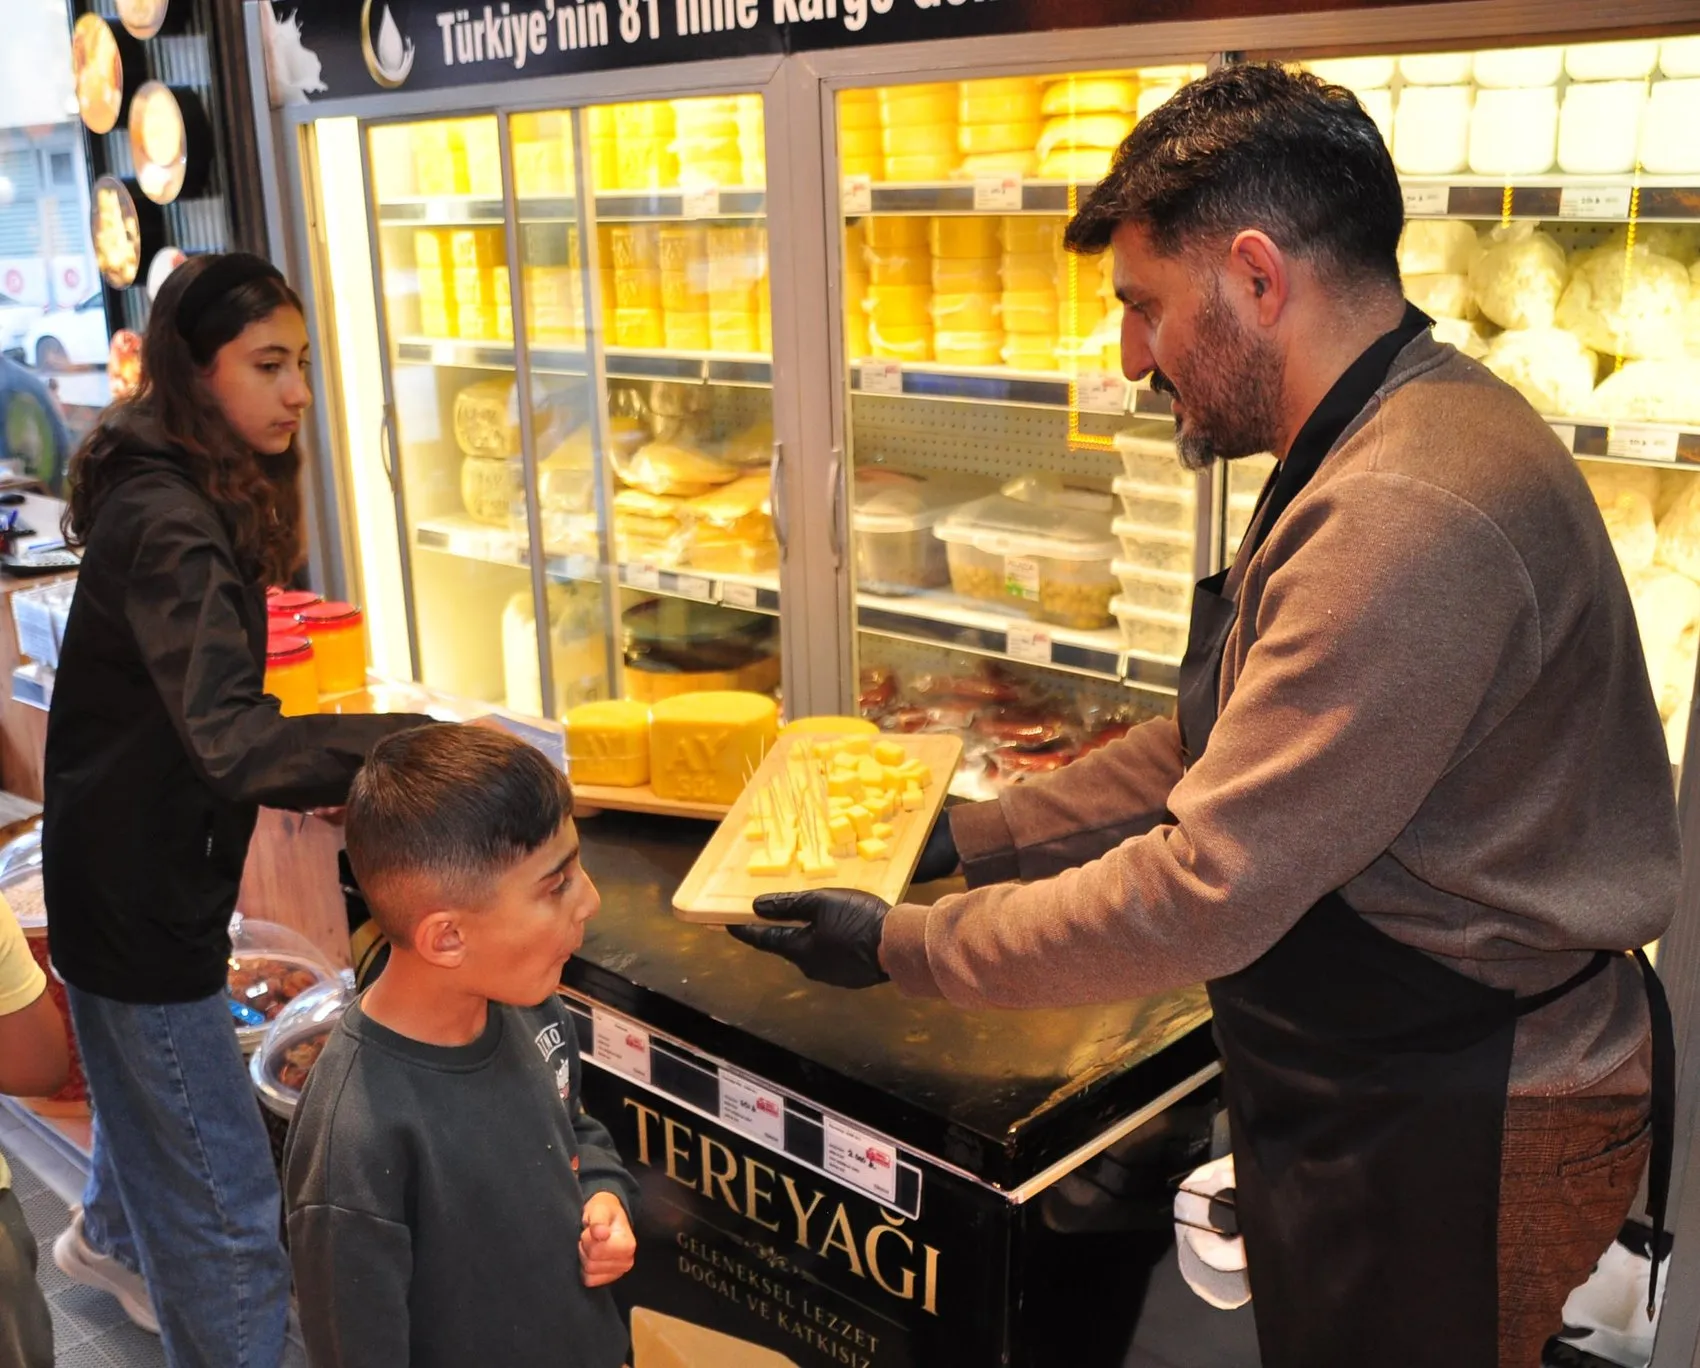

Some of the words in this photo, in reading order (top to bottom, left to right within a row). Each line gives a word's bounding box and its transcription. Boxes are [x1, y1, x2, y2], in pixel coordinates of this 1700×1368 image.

[436, 0, 609, 69] Türkiye'nin
[619, 0, 660, 43] 81
[623, 1098, 942, 1317] TEREYAĞI
[676, 1231, 795, 1309] GELENEKSEL
[803, 1300, 880, 1354] LEZZET
[678, 1256, 741, 1304] DOĞAL
[746, 1294, 770, 1321] VE
